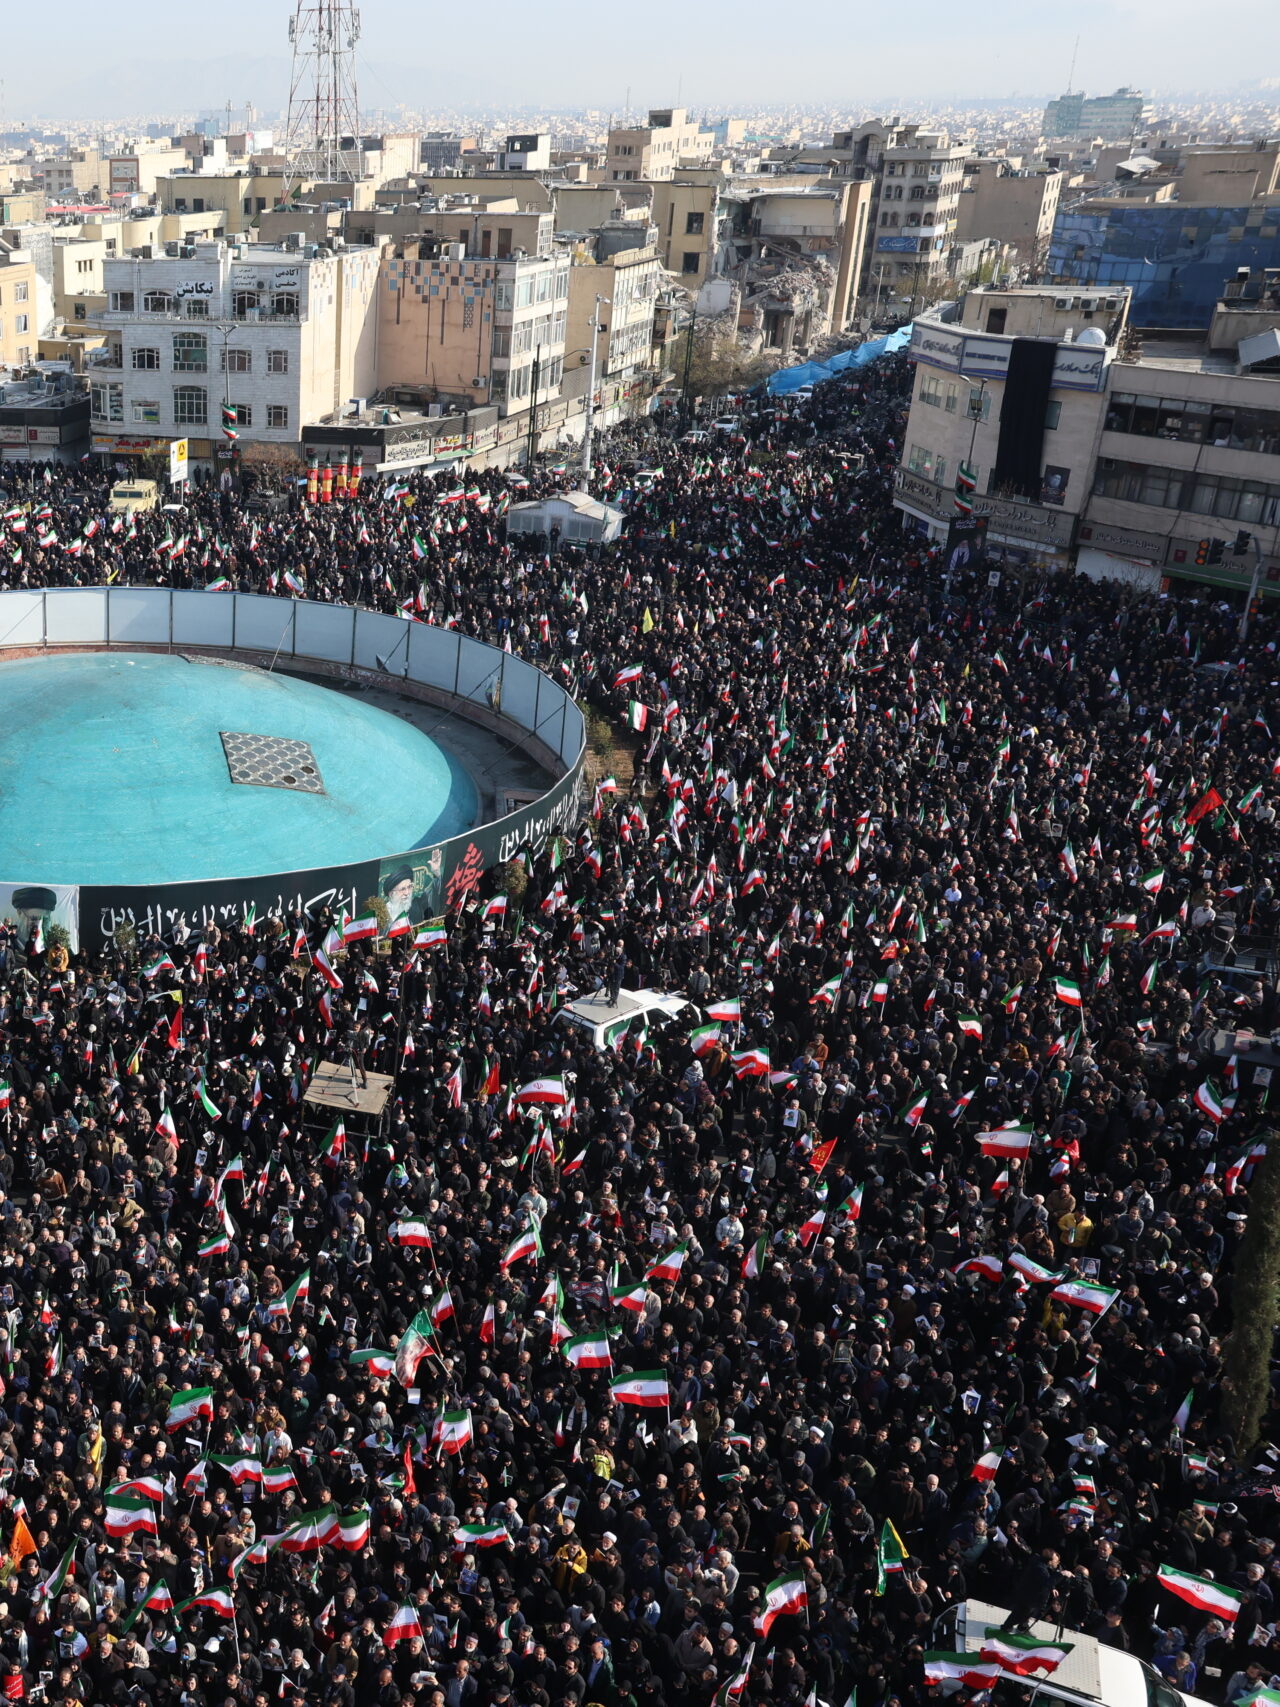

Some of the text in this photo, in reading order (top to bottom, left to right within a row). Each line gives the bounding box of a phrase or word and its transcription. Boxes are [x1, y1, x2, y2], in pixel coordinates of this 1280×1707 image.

[275, 268, 299, 278] آکادمی
[177, 281, 213, 297] نیکایش
[995, 506, 1032, 521] صادرات
[1032, 511, 1057, 532] بانک
